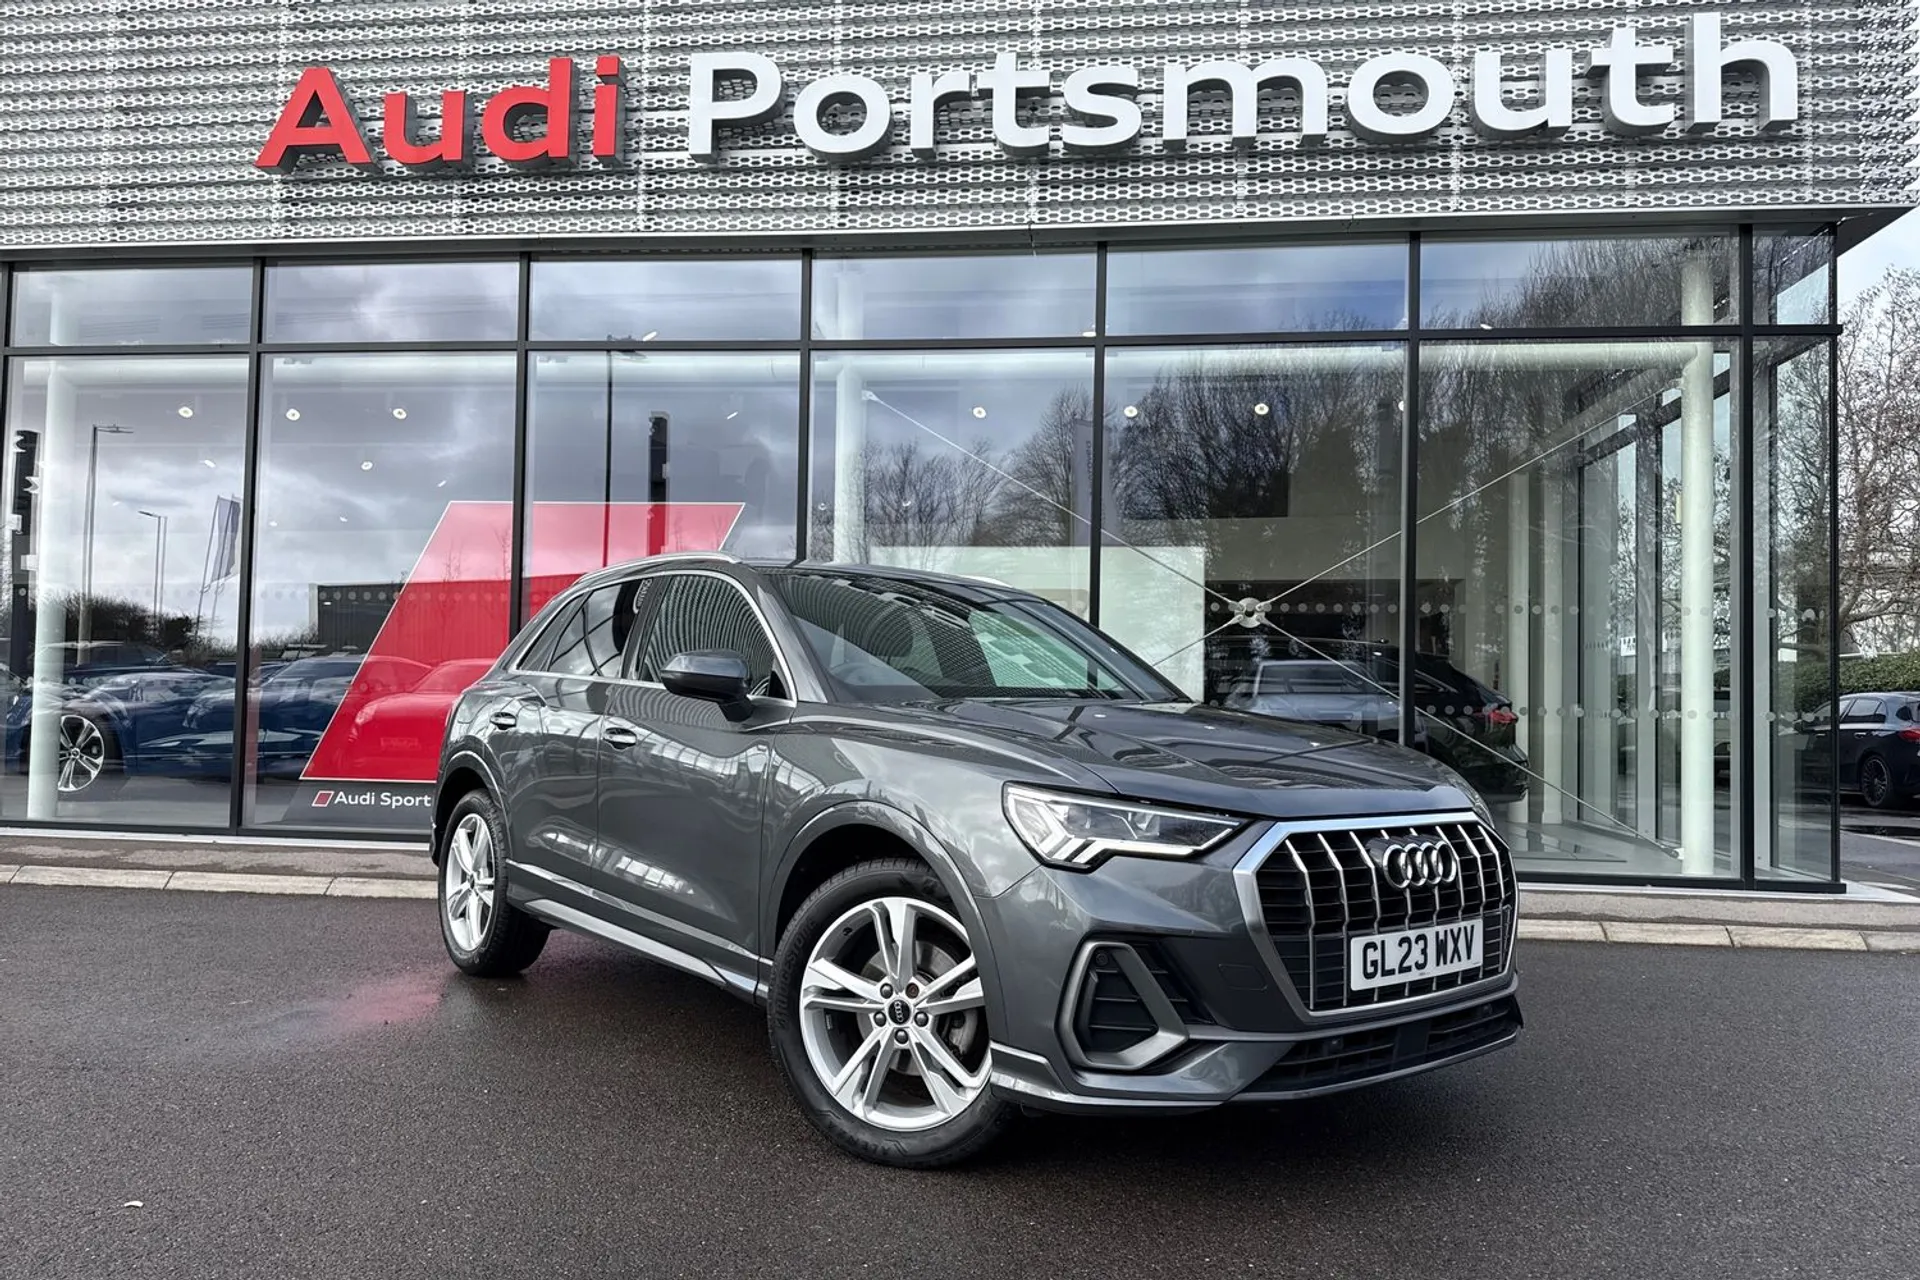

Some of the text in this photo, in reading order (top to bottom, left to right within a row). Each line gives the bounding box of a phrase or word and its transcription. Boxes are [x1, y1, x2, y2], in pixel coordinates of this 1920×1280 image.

[256, 12, 1799, 168] Audi Portsmouth
[334, 791, 431, 809] Audi Sport
[1362, 924, 1476, 980] GL23 WXV
